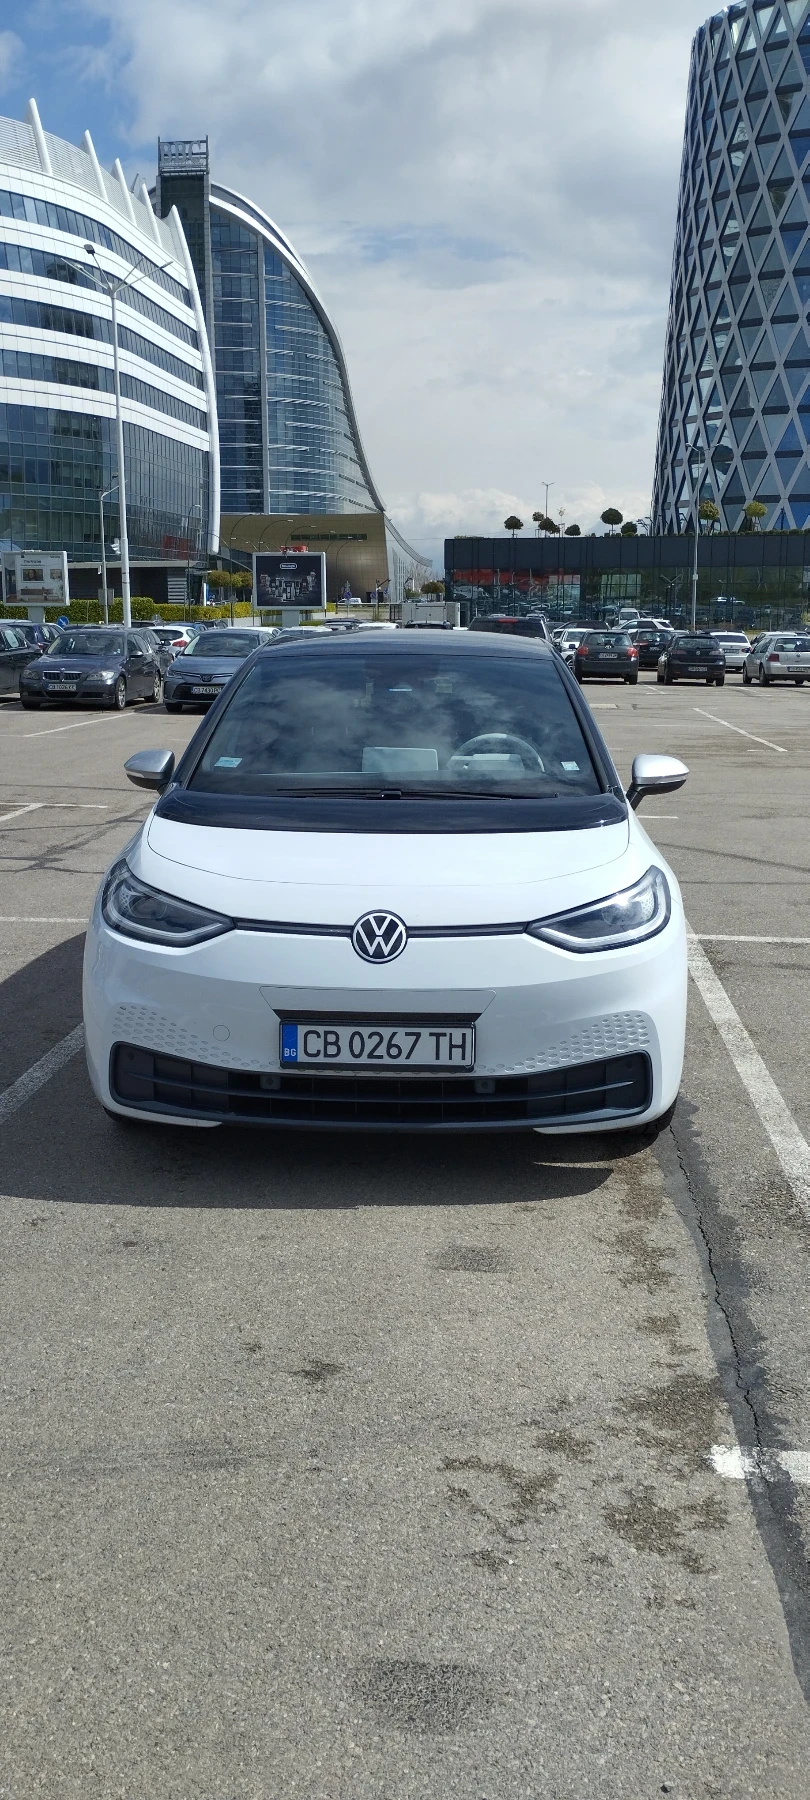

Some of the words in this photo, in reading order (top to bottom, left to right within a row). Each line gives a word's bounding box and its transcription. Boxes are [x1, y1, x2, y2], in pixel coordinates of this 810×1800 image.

[284, 1048, 296, 1057] BG
[303, 1030, 342, 1058] CB
[348, 1031, 422, 1060] 0267
[428, 1032, 467, 1061] TH
